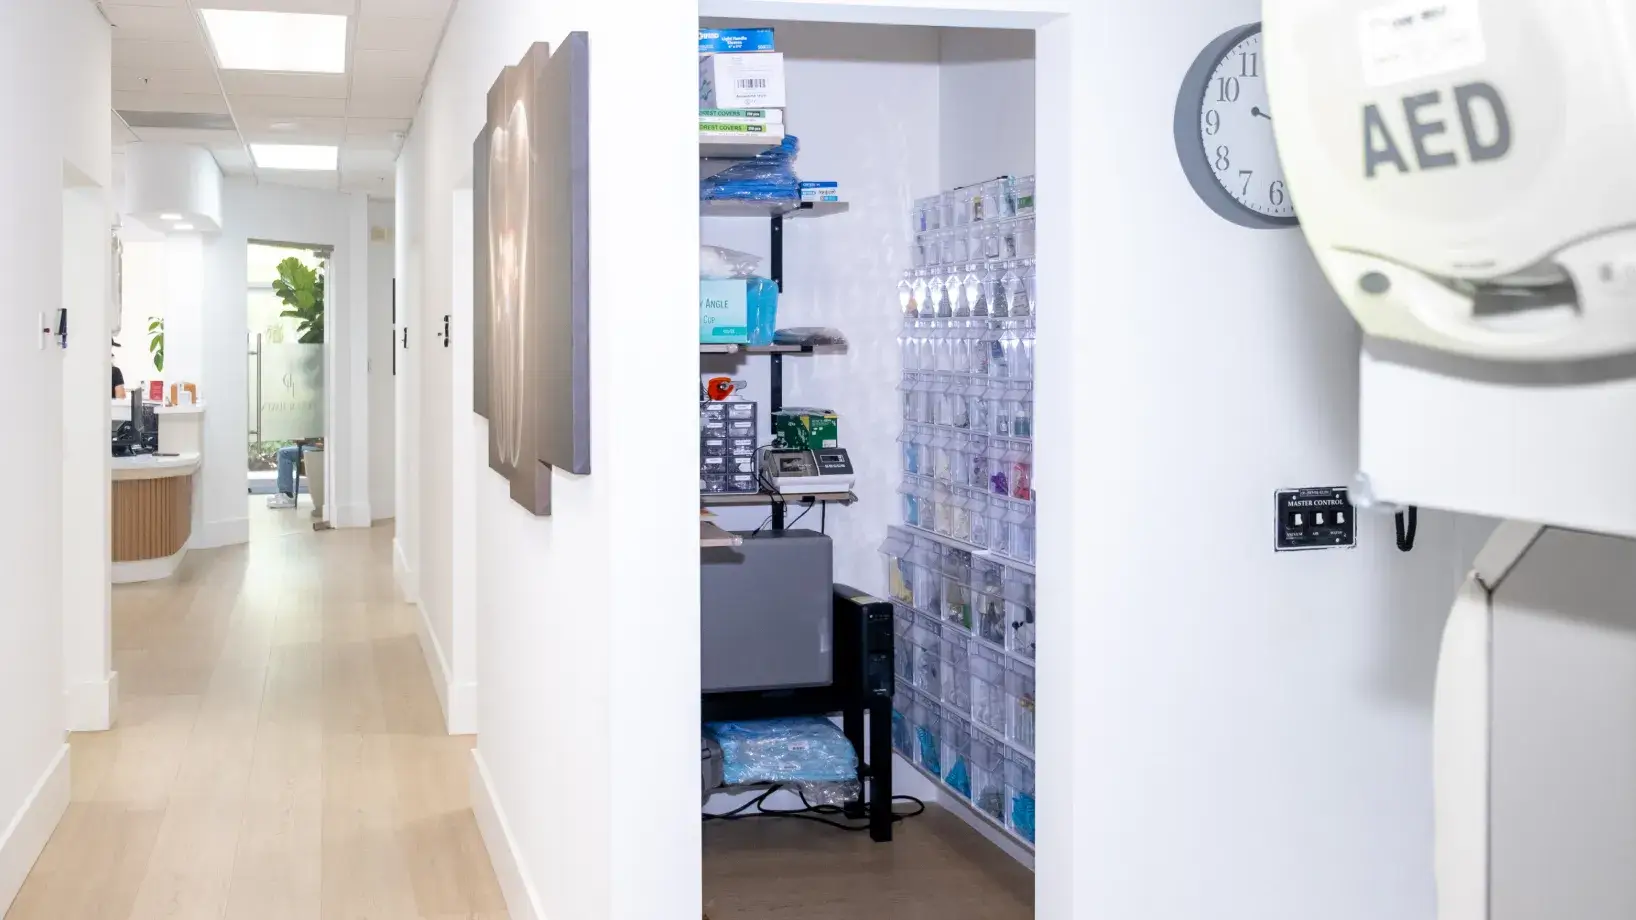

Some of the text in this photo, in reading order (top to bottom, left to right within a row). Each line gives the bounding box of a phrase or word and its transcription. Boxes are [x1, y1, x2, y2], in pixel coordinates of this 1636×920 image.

[1238, 52, 1258, 77] 11
[1216, 77, 1240, 102] 10
[1205, 109, 1220, 135] 9
[1363, 80, 1512, 178] AED
[1215, 145, 1230, 170] 8
[1238, 170, 1253, 196] 7
[1269, 180, 1284, 206] 6
